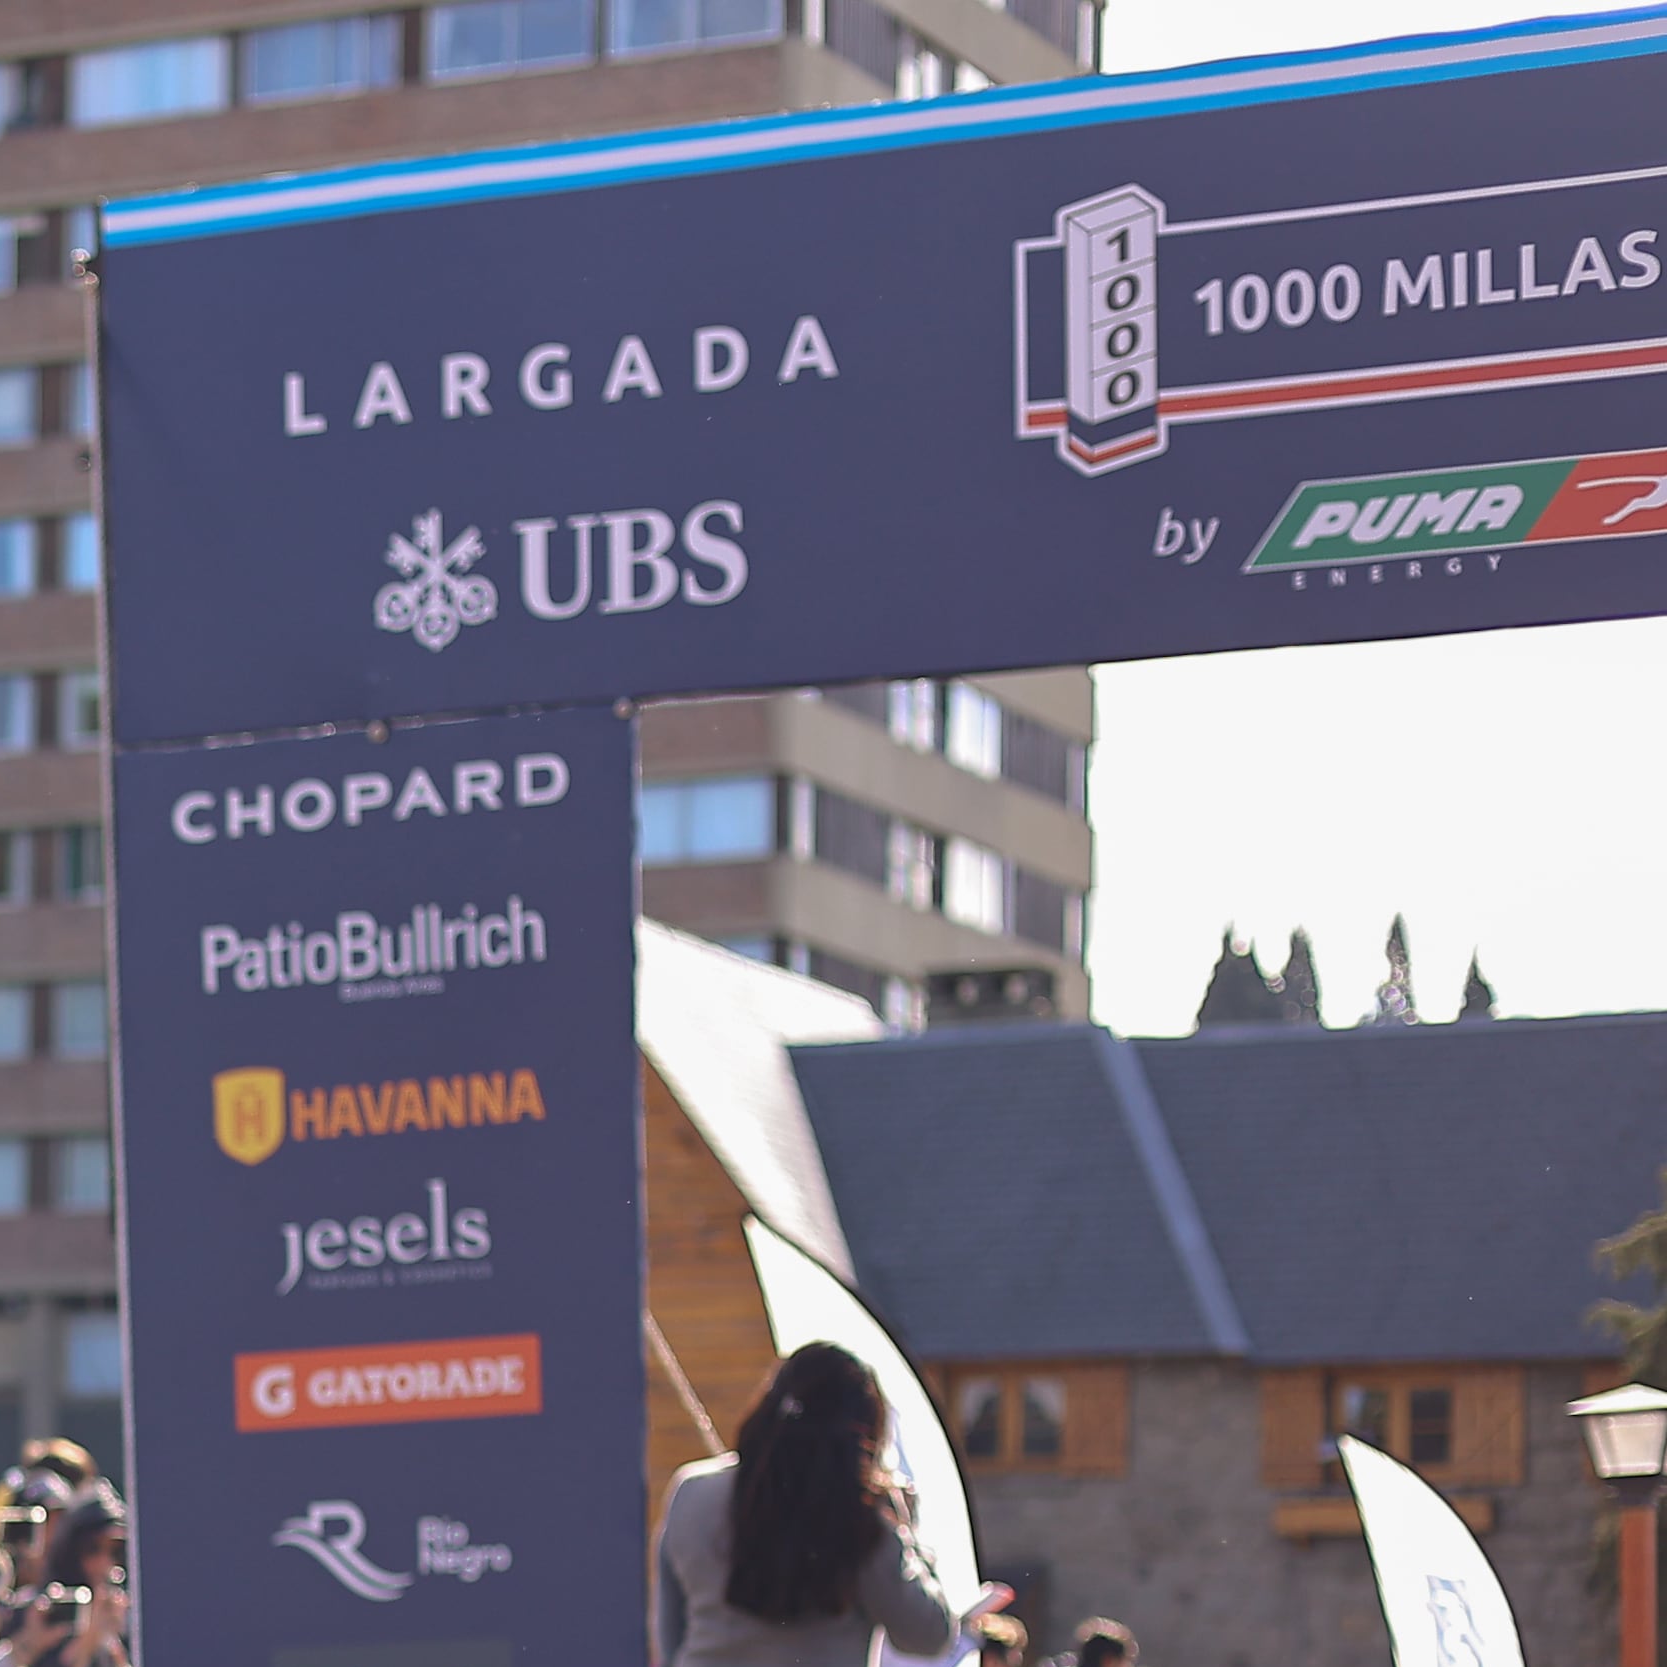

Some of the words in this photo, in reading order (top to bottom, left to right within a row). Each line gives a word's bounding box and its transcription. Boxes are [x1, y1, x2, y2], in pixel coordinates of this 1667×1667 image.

[1194, 263, 1362, 335] 1000
[1382, 229, 1661, 316] MILLAS
[283, 314, 840, 437] LARGADA
[511, 498, 750, 622] UBS
[1153, 506, 1221, 565] by
[1291, 484, 1524, 548] PUMA
[1291, 553, 1502, 591] ENERGY
[171, 751, 571, 844] CHOPARD
[200, 893, 547, 995] PatioBullrich
[289, 1067, 547, 1141] HAVANNA
[306, 1354, 526, 1408] GATORADE
